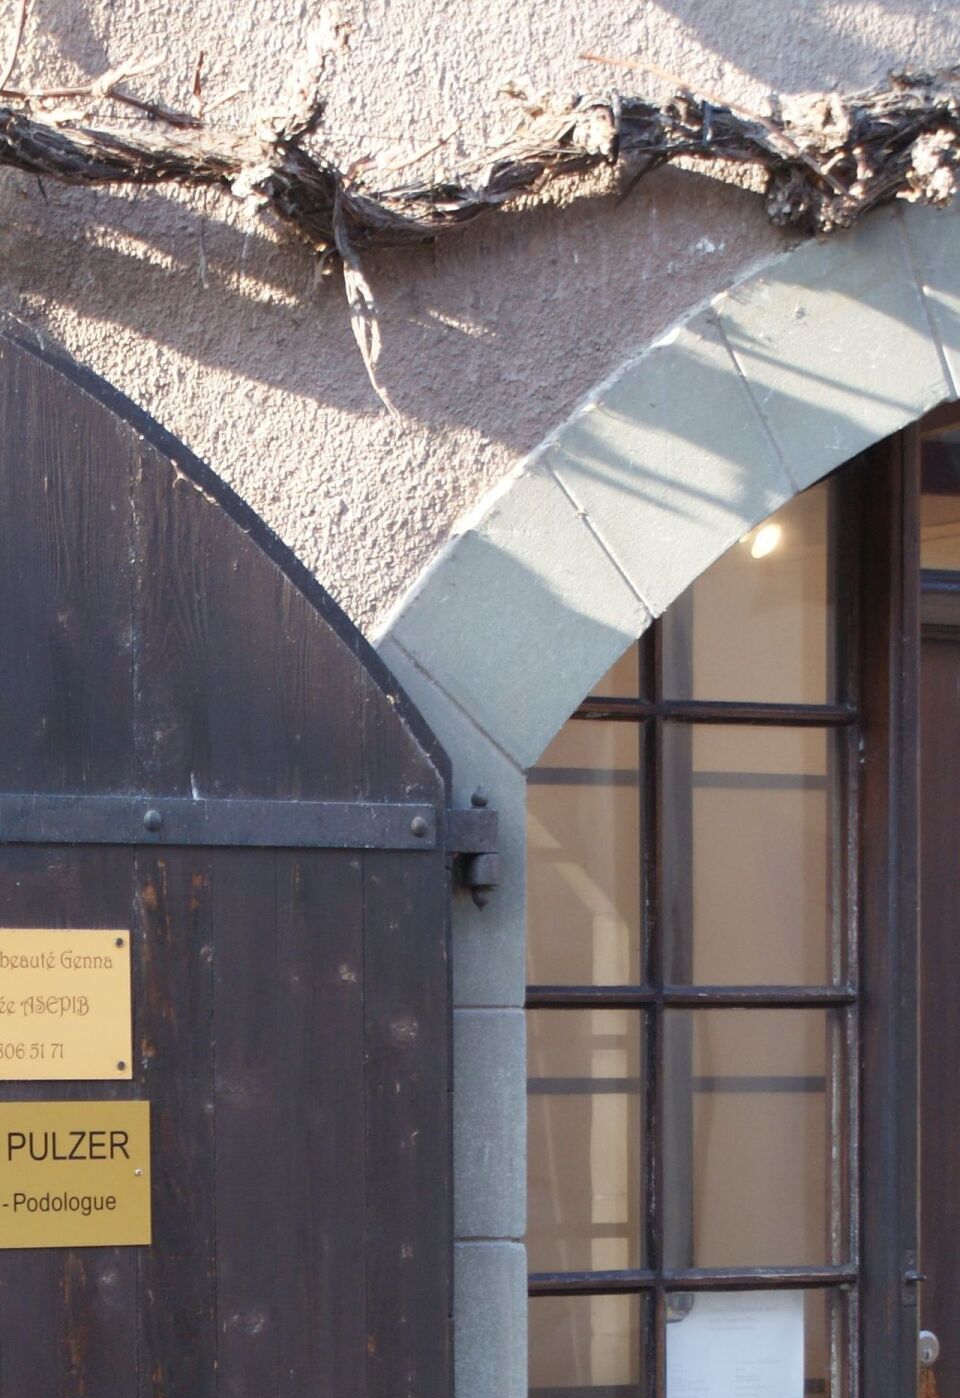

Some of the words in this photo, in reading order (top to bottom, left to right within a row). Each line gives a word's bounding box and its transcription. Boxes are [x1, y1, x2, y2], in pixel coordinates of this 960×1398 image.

[0, 950, 55, 970] beauté
[59, 950, 113, 970] Genna
[29, 1043, 45, 1060] 51
[50, 1043, 64, 1060] 71
[7, 1130, 130, 1162] PULZER
[13, 1192, 116, 1217] Podologue
